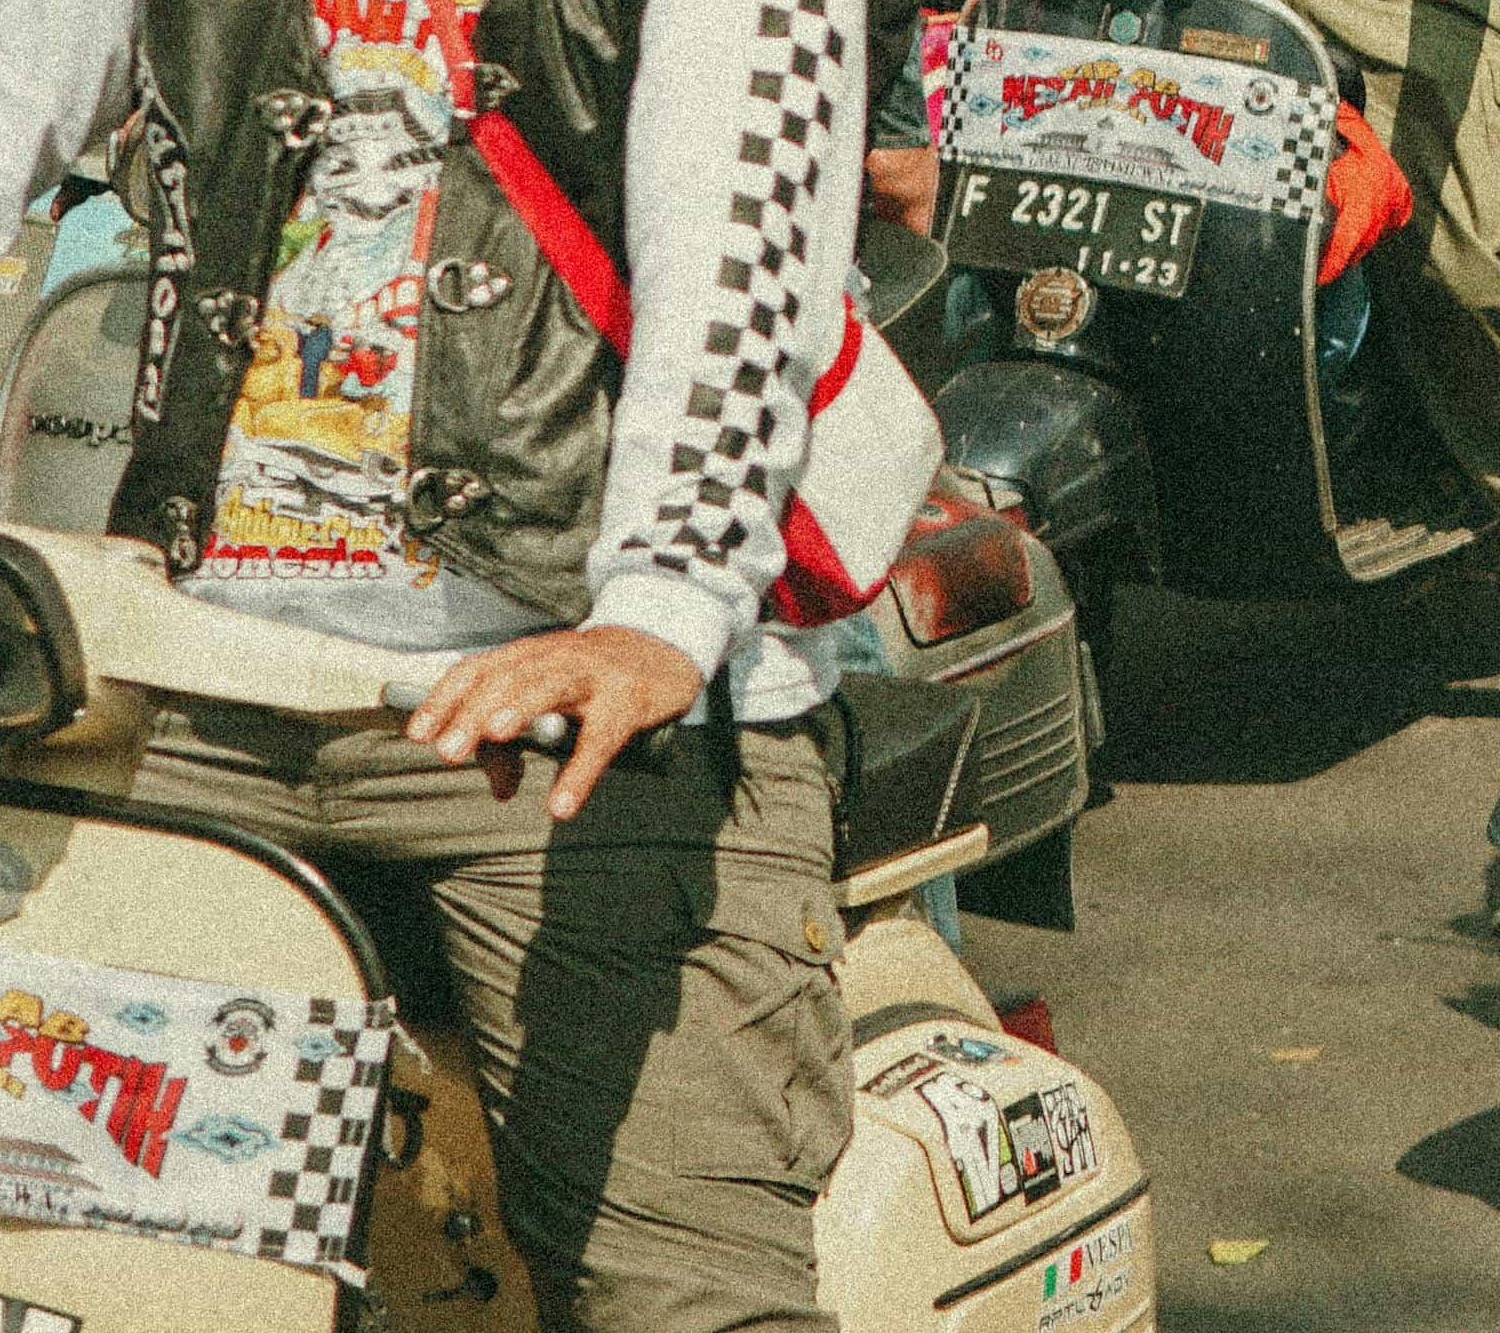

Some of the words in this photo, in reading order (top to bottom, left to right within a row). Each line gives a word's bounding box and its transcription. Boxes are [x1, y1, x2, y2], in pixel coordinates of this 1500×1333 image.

[1002, 74, 1117, 135] MERAH
[1126, 83, 1235, 166] PUTIH
[961, 174, 990, 217] F
[1011, 180, 1110, 234] 2321
[1140, 199, 1193, 246] ST
